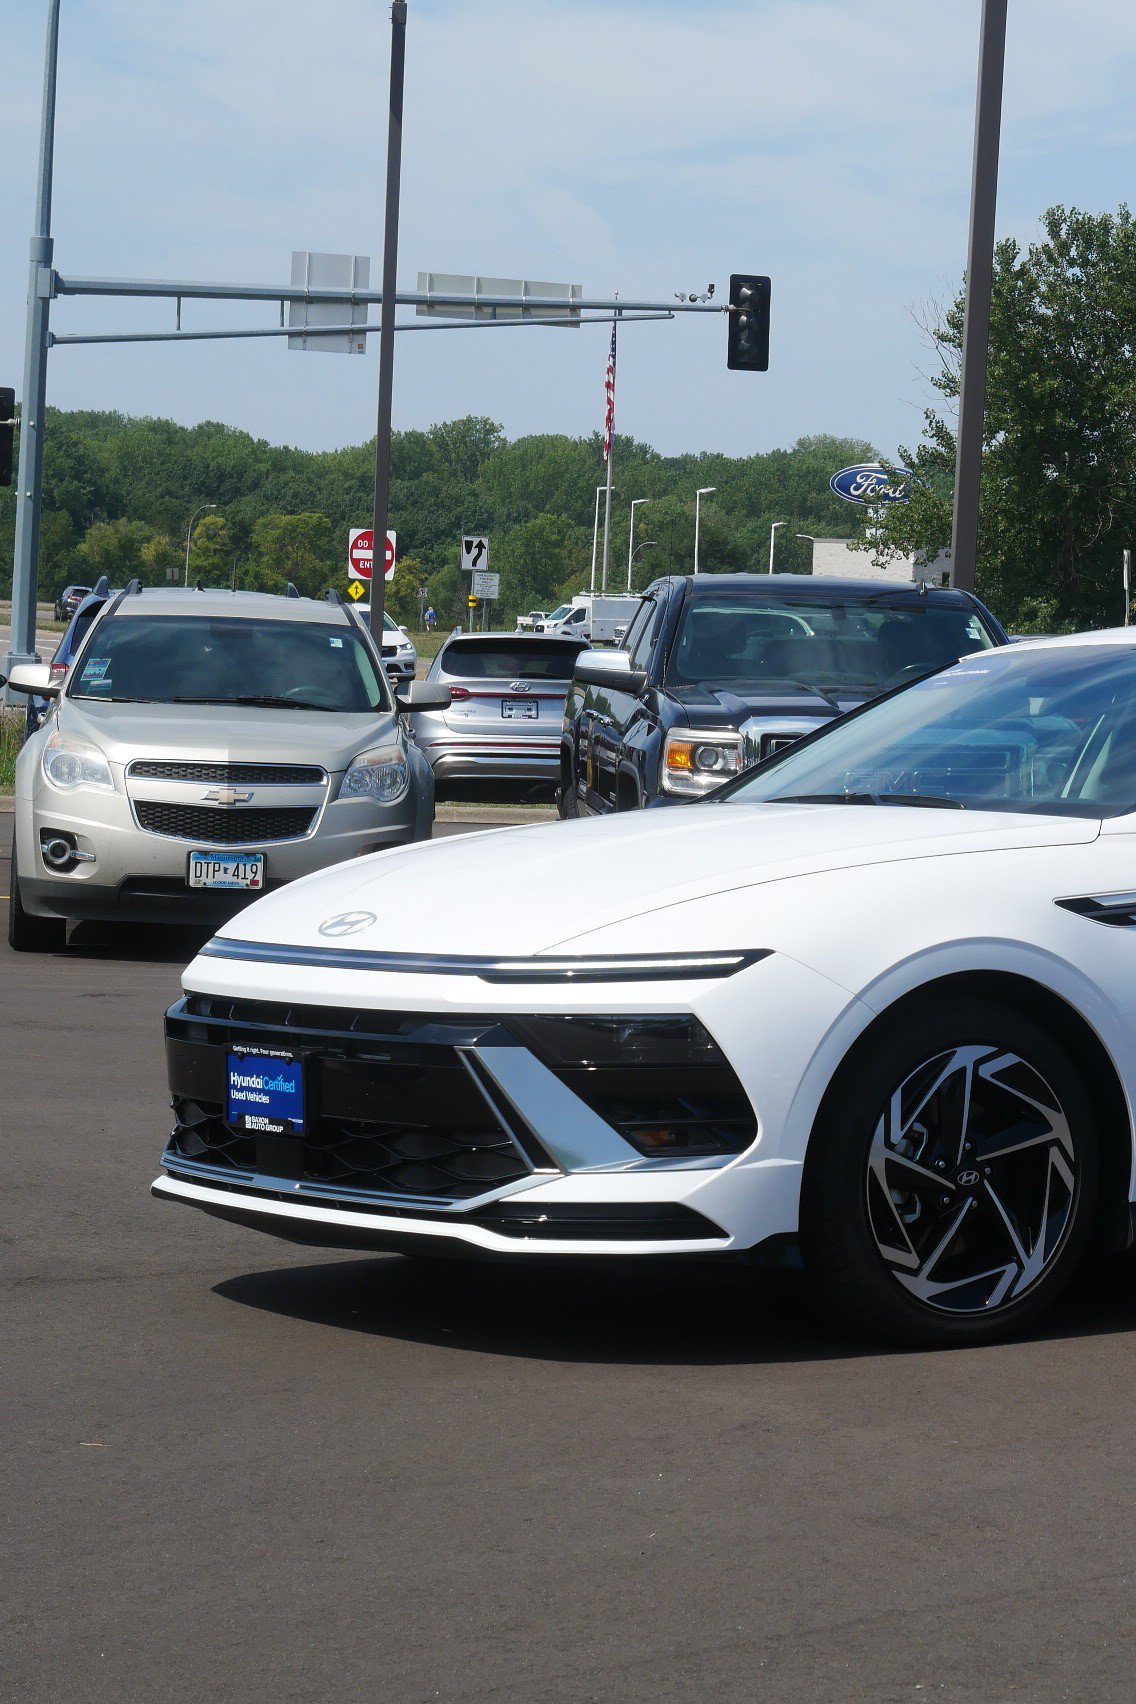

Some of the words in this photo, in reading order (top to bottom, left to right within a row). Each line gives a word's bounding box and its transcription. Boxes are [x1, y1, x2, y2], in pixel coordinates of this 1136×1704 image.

[849, 471, 906, 498] Ford
[357, 539, 369, 548] DO
[194, 861, 221, 879] DTP
[231, 863, 259, 880] 419
[230, 1072, 263, 1089] Hyundai
[263, 1076, 296, 1093] Certified
[231, 1089, 246, 1101] Used
[246, 1091, 270, 1104] Vehicles
[251, 1115, 269, 1125] SAXON
[251, 1122, 265, 1131] AUTO
[265, 1124, 284, 1133] GROUP
